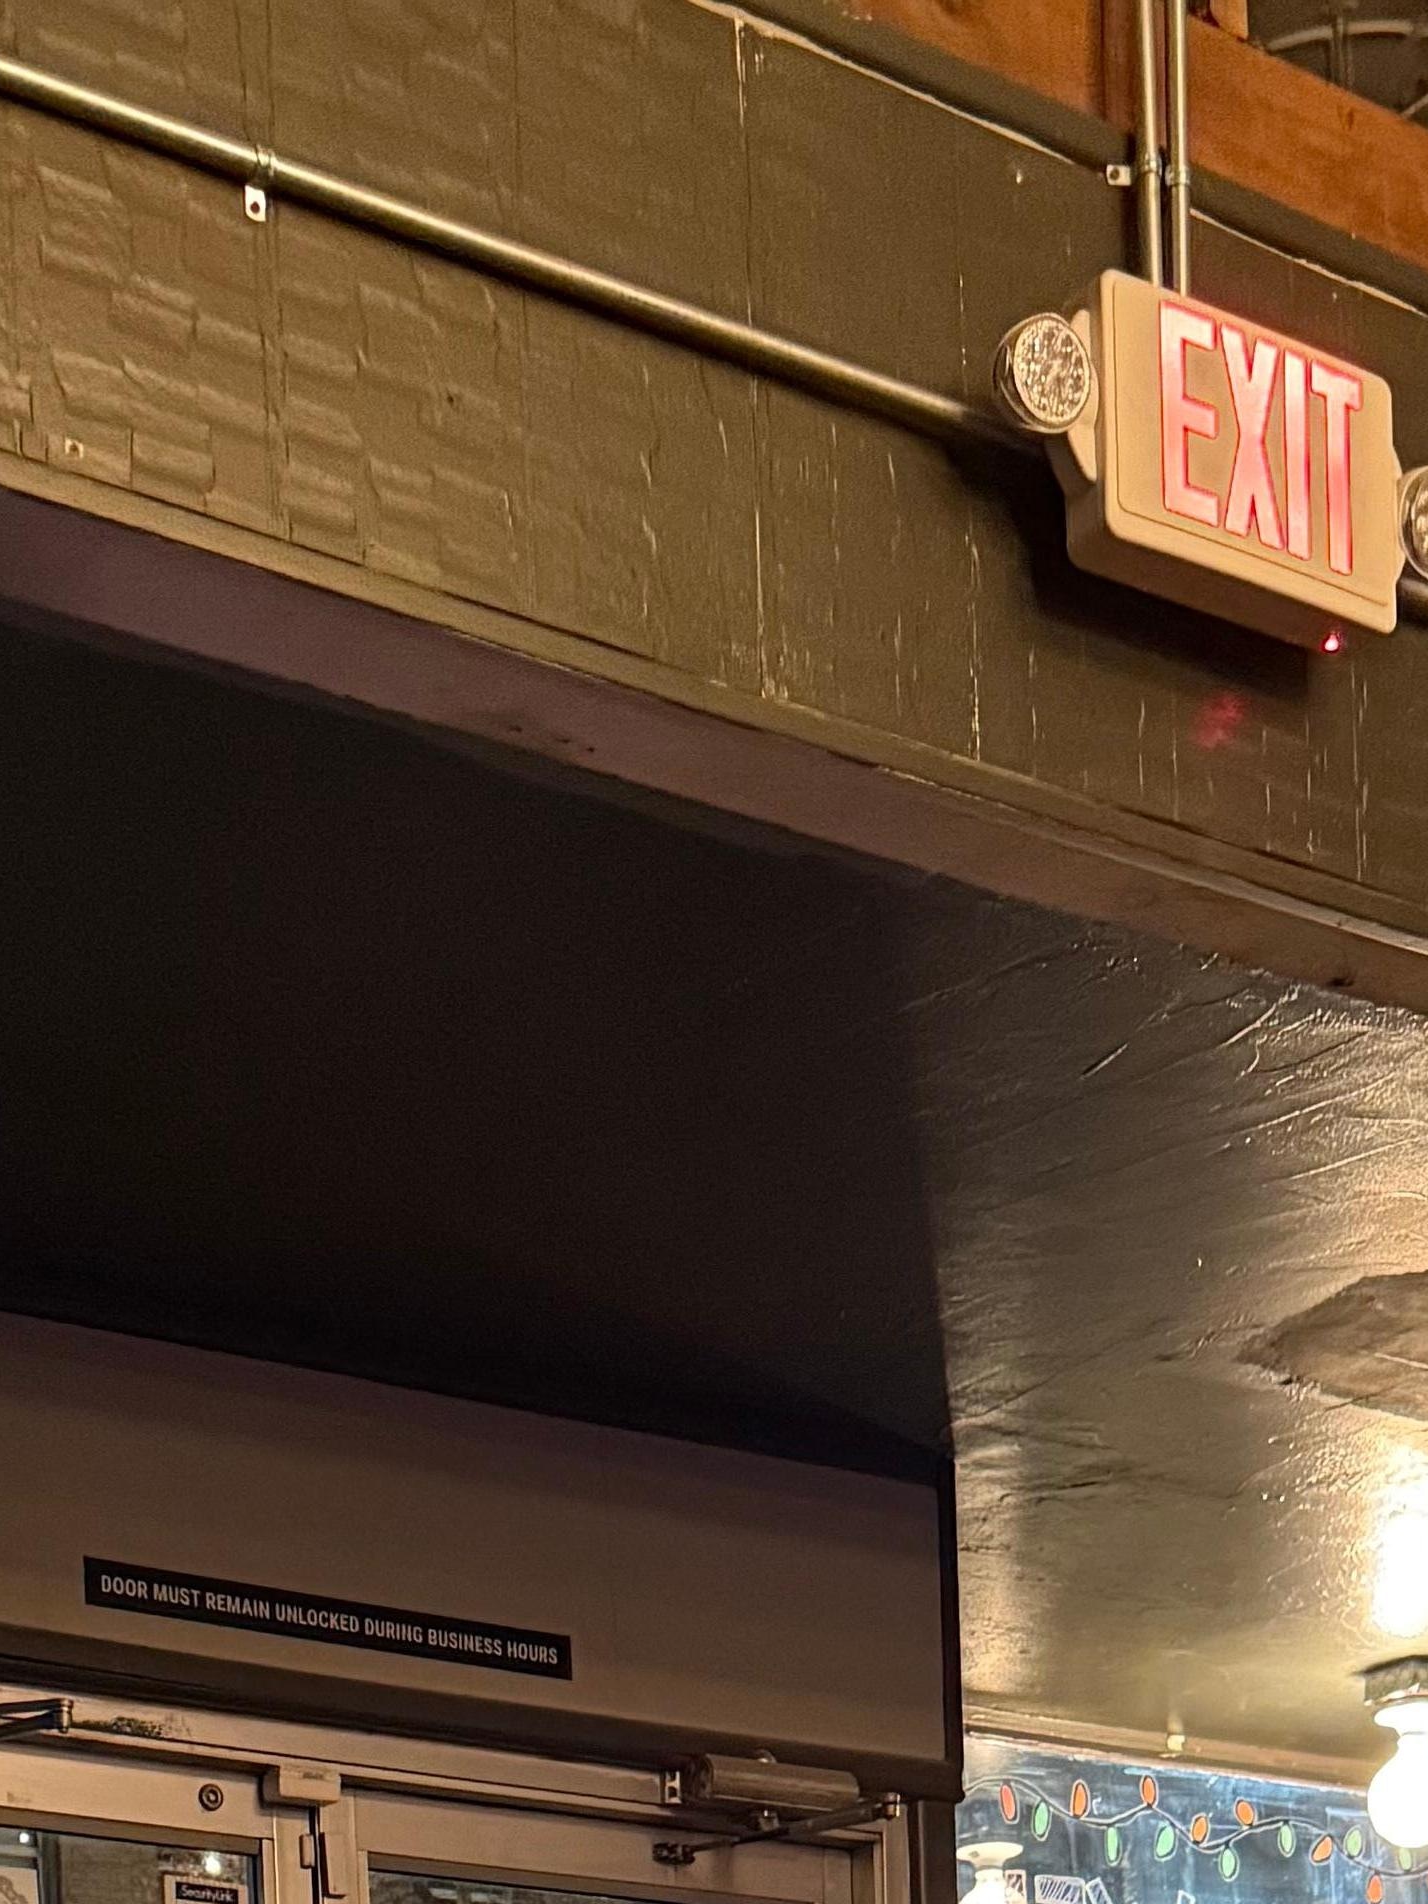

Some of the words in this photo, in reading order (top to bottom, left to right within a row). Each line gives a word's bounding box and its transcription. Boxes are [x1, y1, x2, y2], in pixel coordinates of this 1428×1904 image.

[1159, 300, 1363, 576] EXIT
[100, 1573, 148, 1600] DOOR
[153, 1583, 201, 1608] MUST
[205, 1592, 271, 1620] REMAIN
[275, 1604, 360, 1633] UNLOCKED
[364, 1617, 423, 1644] DURING
[428, 1628, 503, 1657] BUSINESS
[507, 1640, 559, 1665] HOURS
